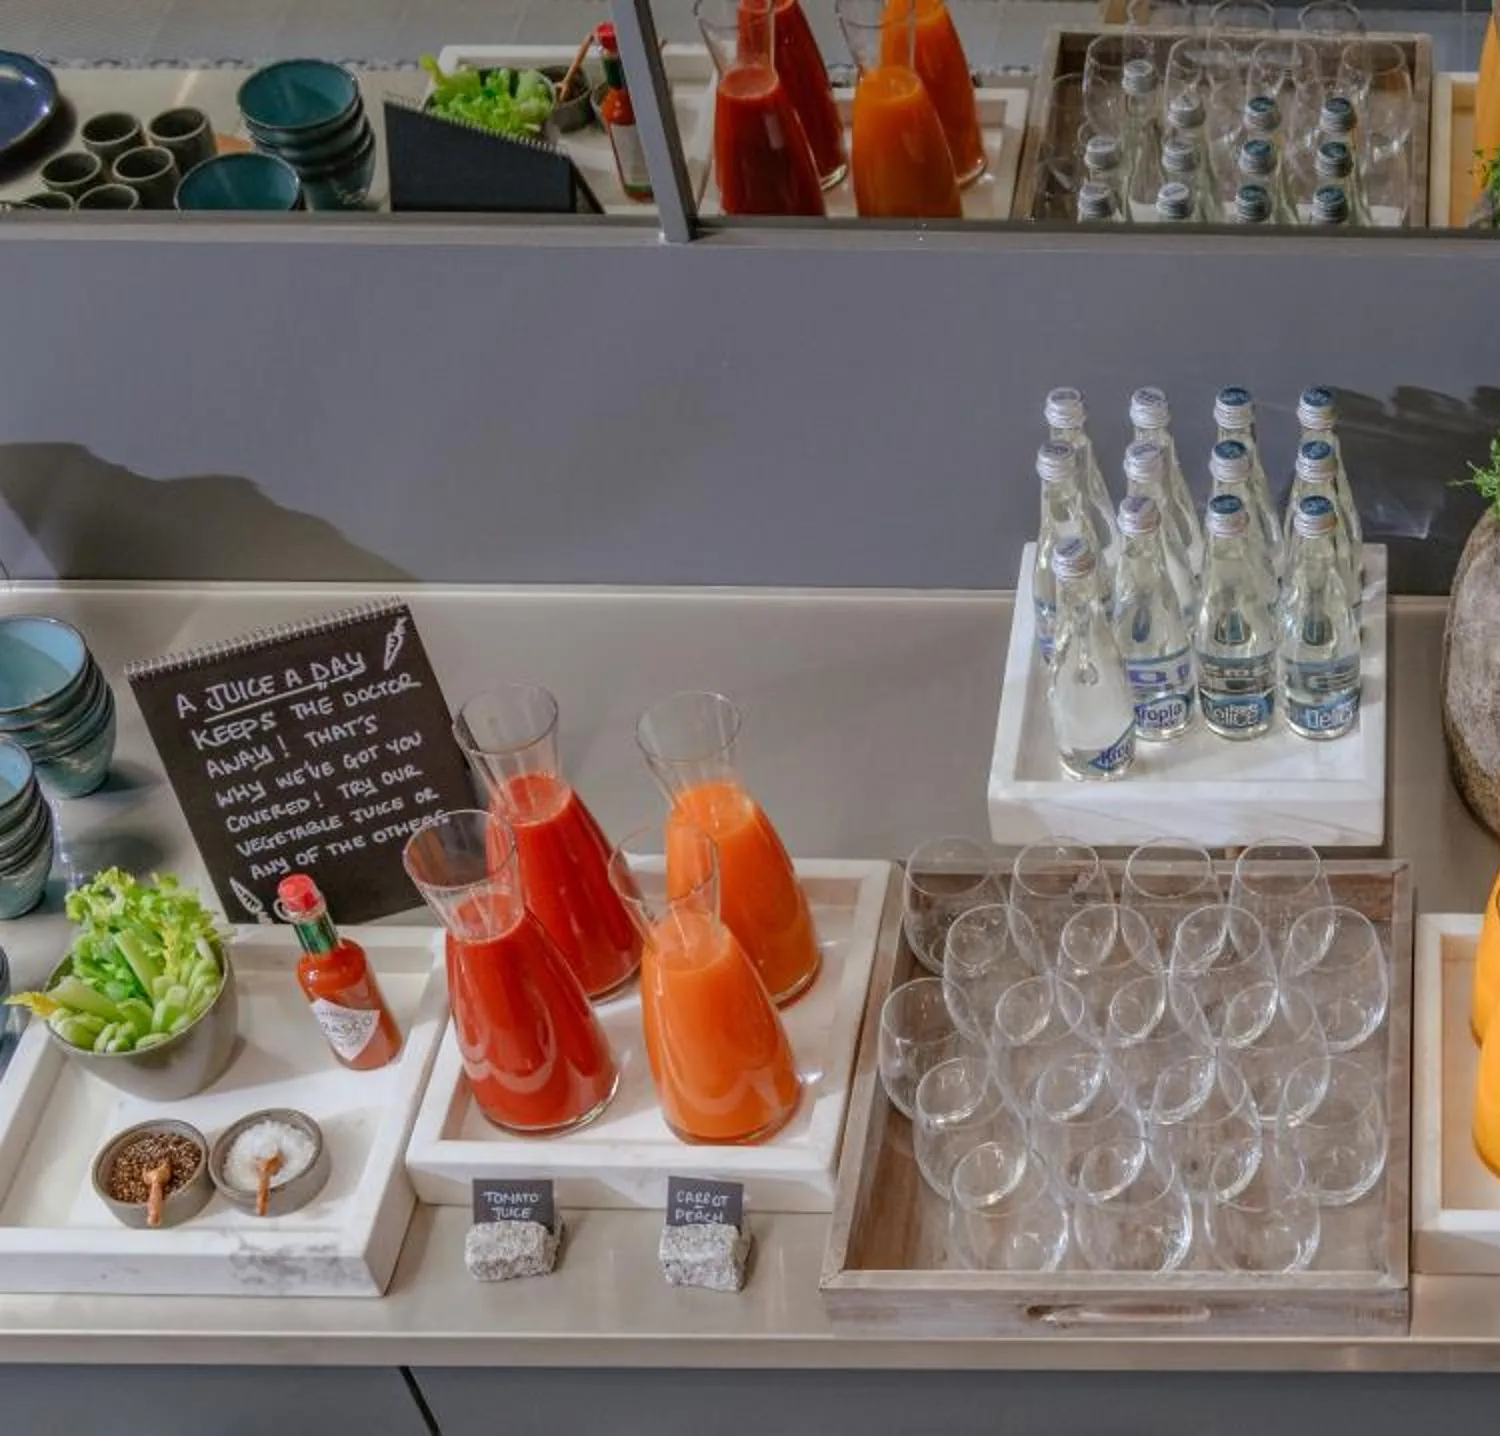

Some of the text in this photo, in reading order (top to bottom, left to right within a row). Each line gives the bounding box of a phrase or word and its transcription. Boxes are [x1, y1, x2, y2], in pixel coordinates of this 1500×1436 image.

[176, 652, 366, 718] A JUICE A DAY
[191, 673, 422, 750] KEEPS THE DOCTOR
[304, 714, 378, 749] THAT'S
[215, 731, 422, 809] WHY WE'VE GOT YOU
[337, 779, 378, 800] TRY
[381, 763, 423, 787] OUR
[236, 787, 440, 858] VEGETABLE JUICE OR
[250, 857, 291, 880] ANY
[299, 848, 320, 867] OF
[325, 838, 367, 858] THE
[480, 1190, 540, 1205] TOMATO
[489, 1206, 533, 1221] JUICE
[675, 1189, 729, 1208] CARROT
